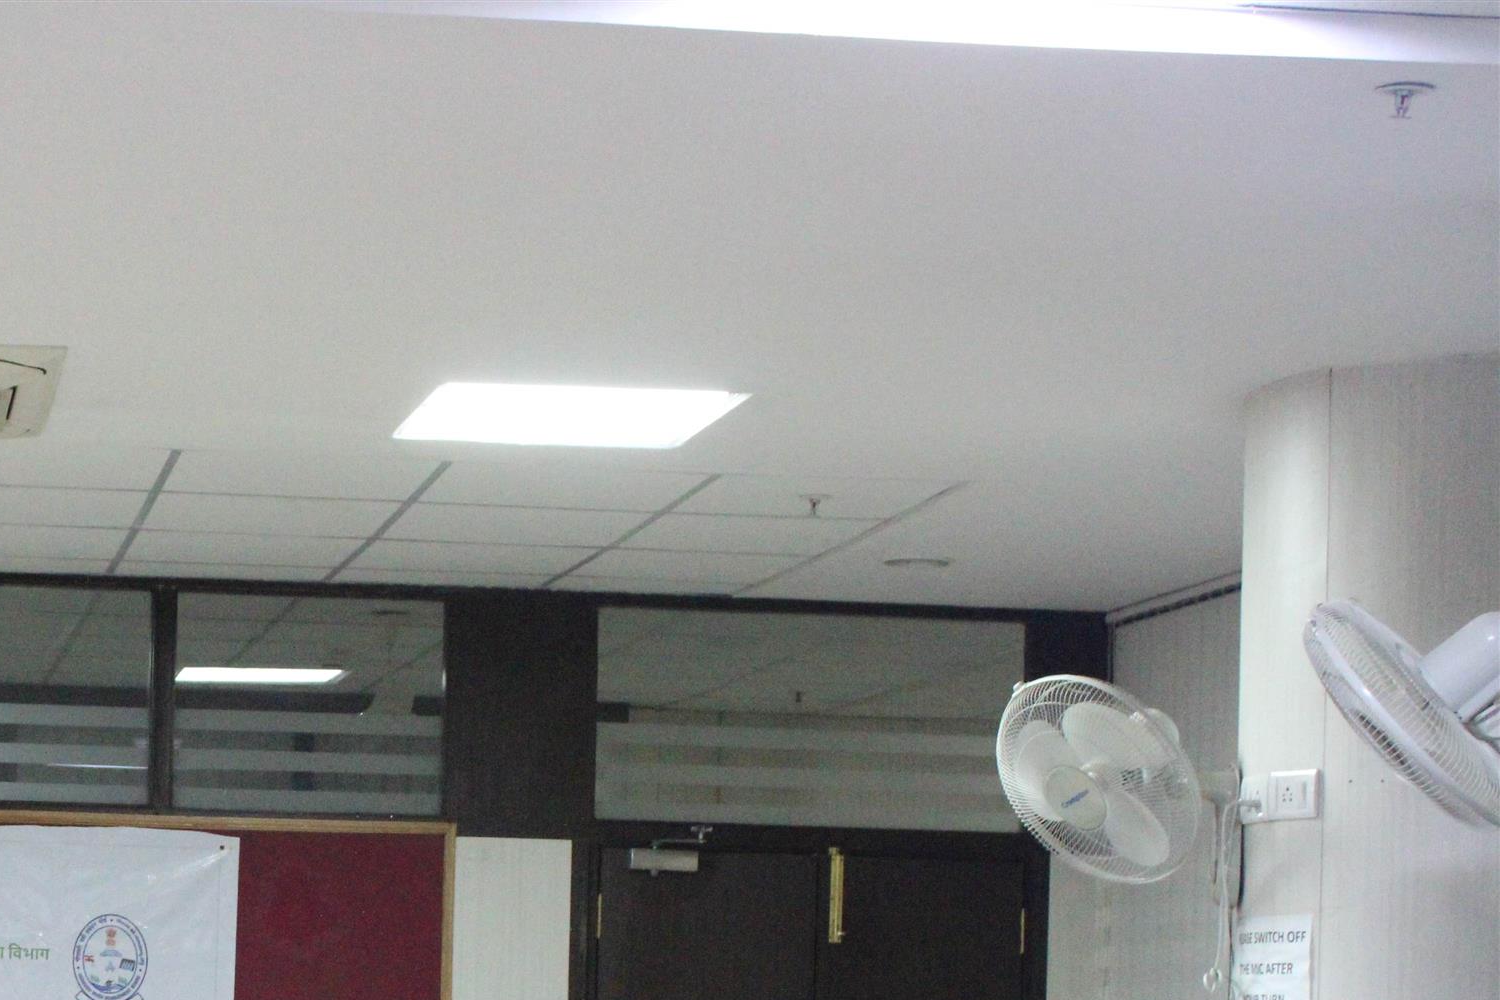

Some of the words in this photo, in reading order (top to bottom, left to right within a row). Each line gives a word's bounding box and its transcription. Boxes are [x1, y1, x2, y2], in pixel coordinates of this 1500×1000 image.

[1254, 931, 1284, 944] SWITCH
[1287, 930, 1306, 944] OFF
[8, 942, 50, 961] विभाग
[1265, 962, 1294, 975] AFTER
